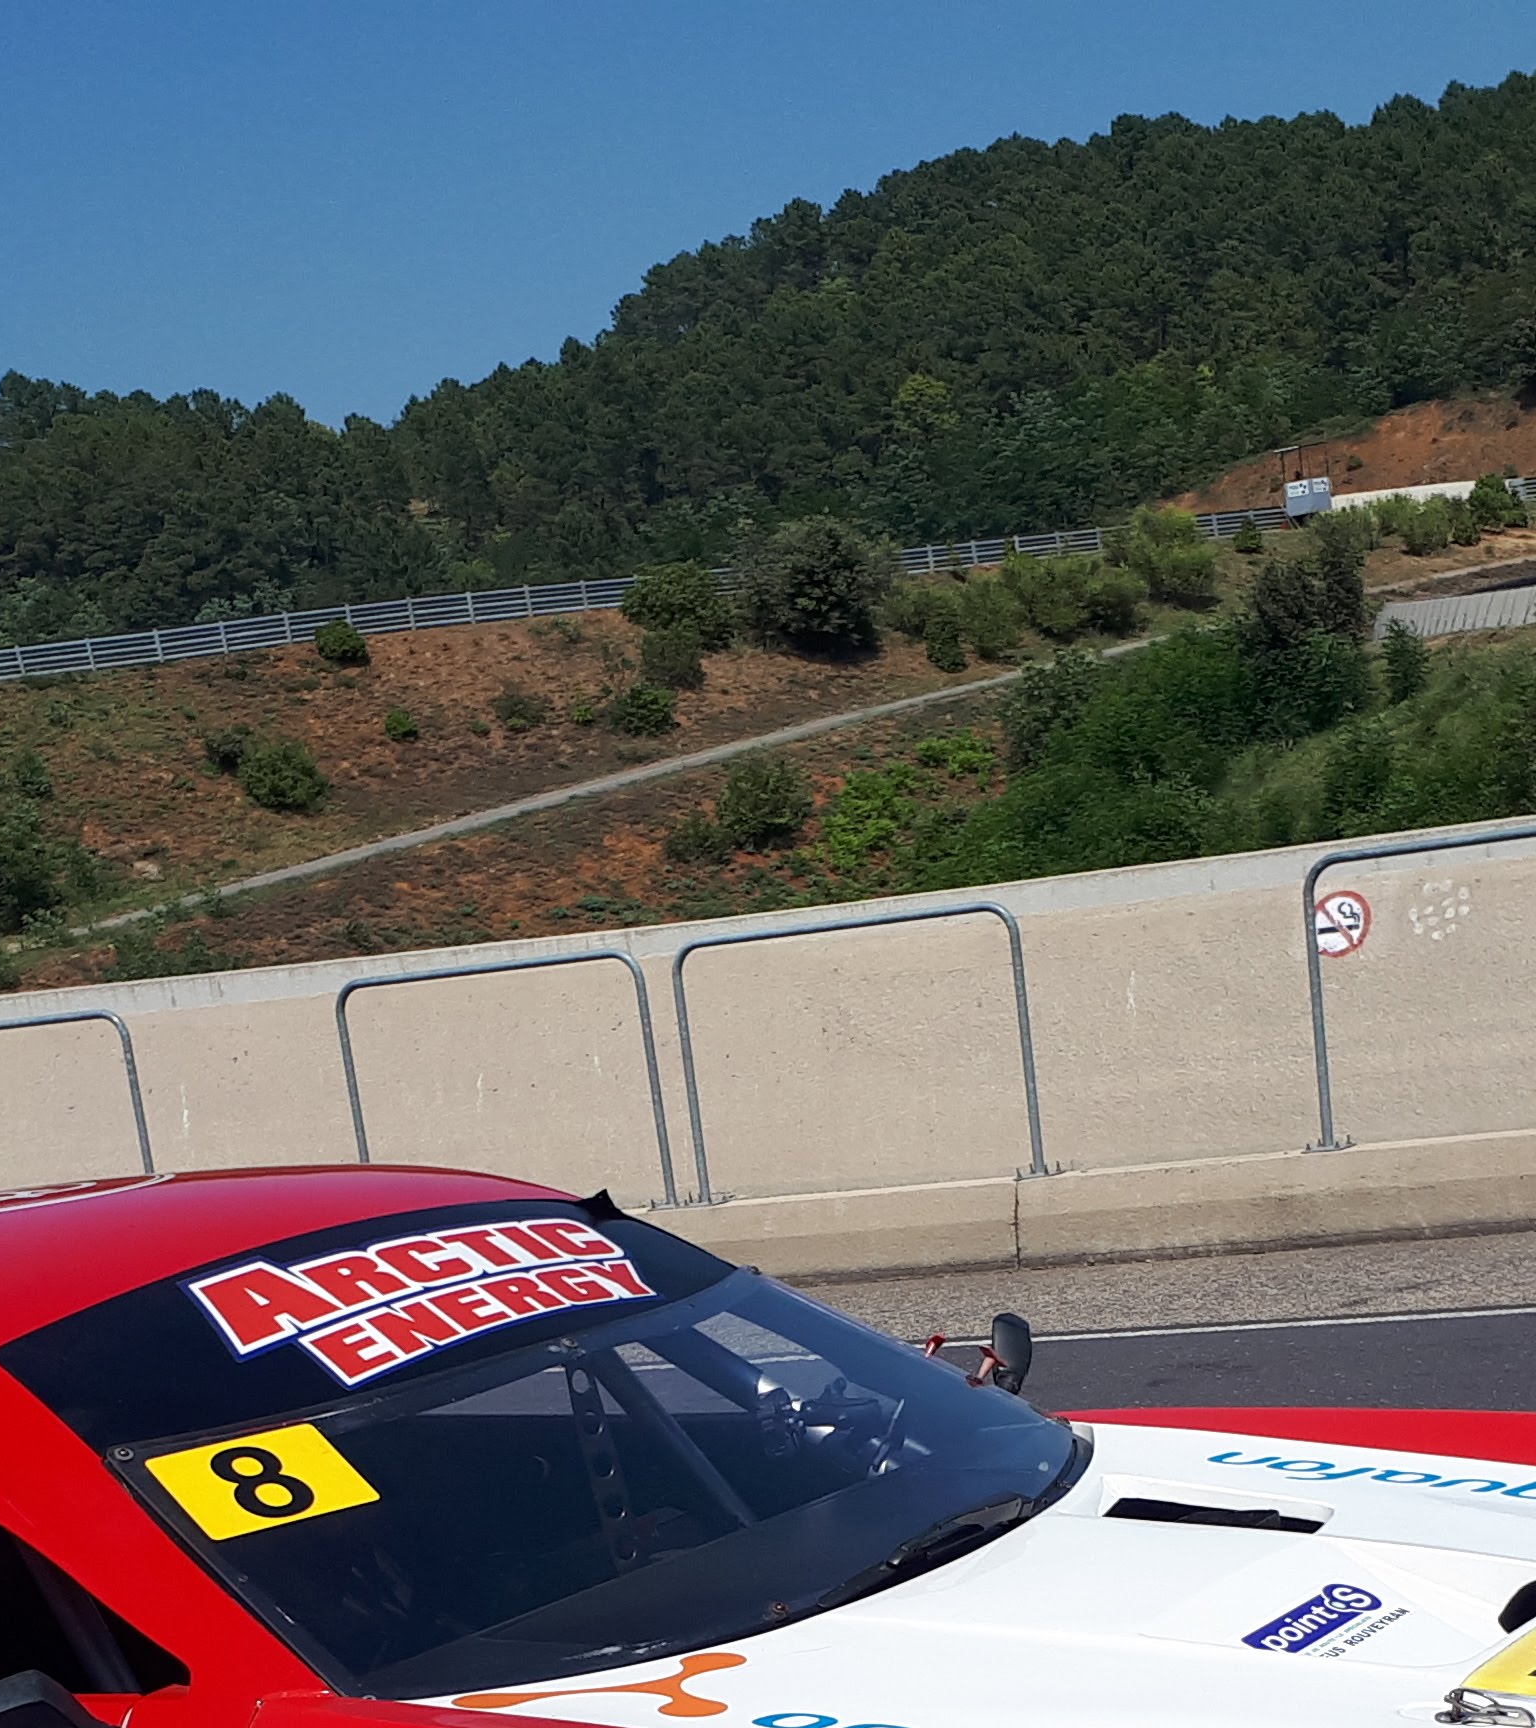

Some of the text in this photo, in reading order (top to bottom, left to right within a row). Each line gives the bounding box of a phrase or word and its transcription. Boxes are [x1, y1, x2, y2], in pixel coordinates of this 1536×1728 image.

[191, 1220, 622, 1353] ARCTIC
[300, 1261, 656, 1385] ENERGY
[210, 1447, 314, 1518] 8
